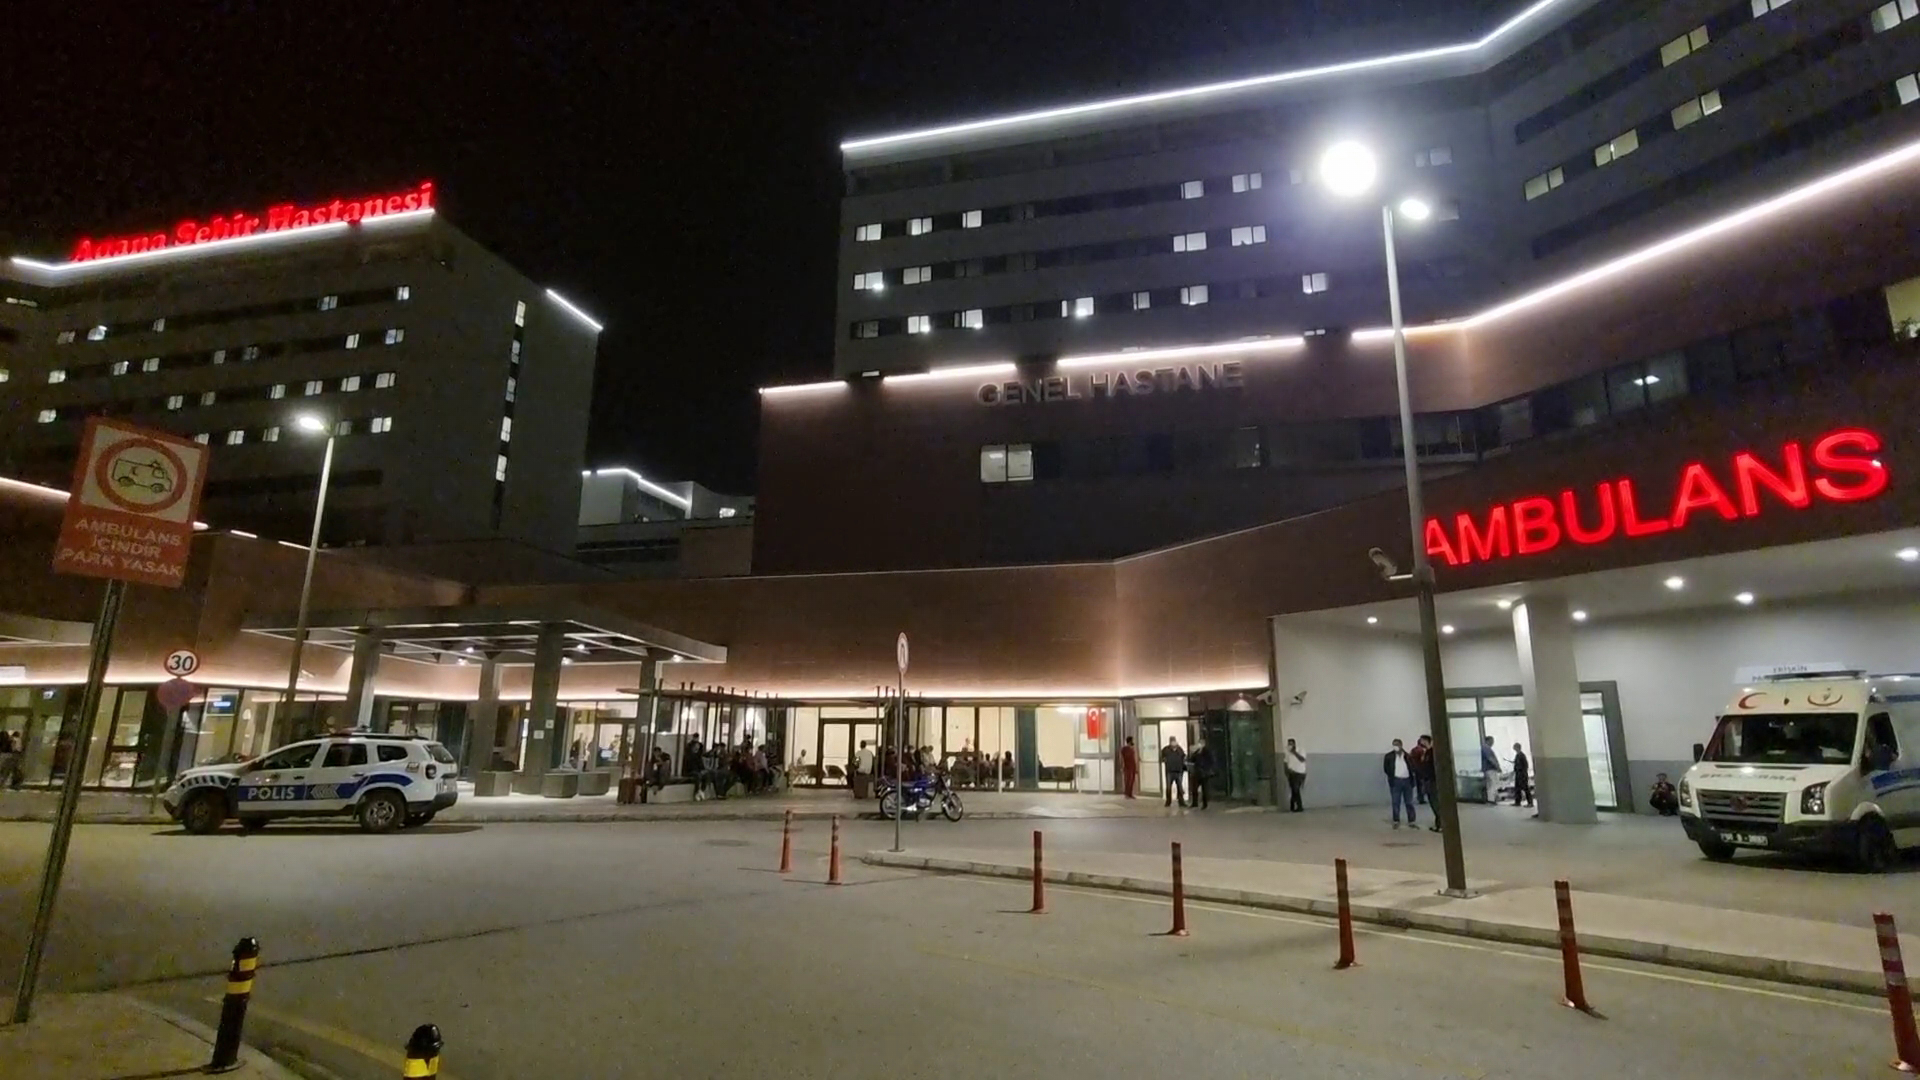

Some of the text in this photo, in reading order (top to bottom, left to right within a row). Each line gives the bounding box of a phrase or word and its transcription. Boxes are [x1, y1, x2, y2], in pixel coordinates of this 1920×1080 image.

[265, 182, 433, 233] Hastanesi
[977, 360, 1245, 407] GENEL HASTANE
[1424, 428, 1890, 566] AMBULANS
[75, 518, 182, 546] AMBULANS
[58, 548, 182, 576] PARK YASAK
[169, 654, 194, 671] 30
[247, 786, 296, 800] POLIS
